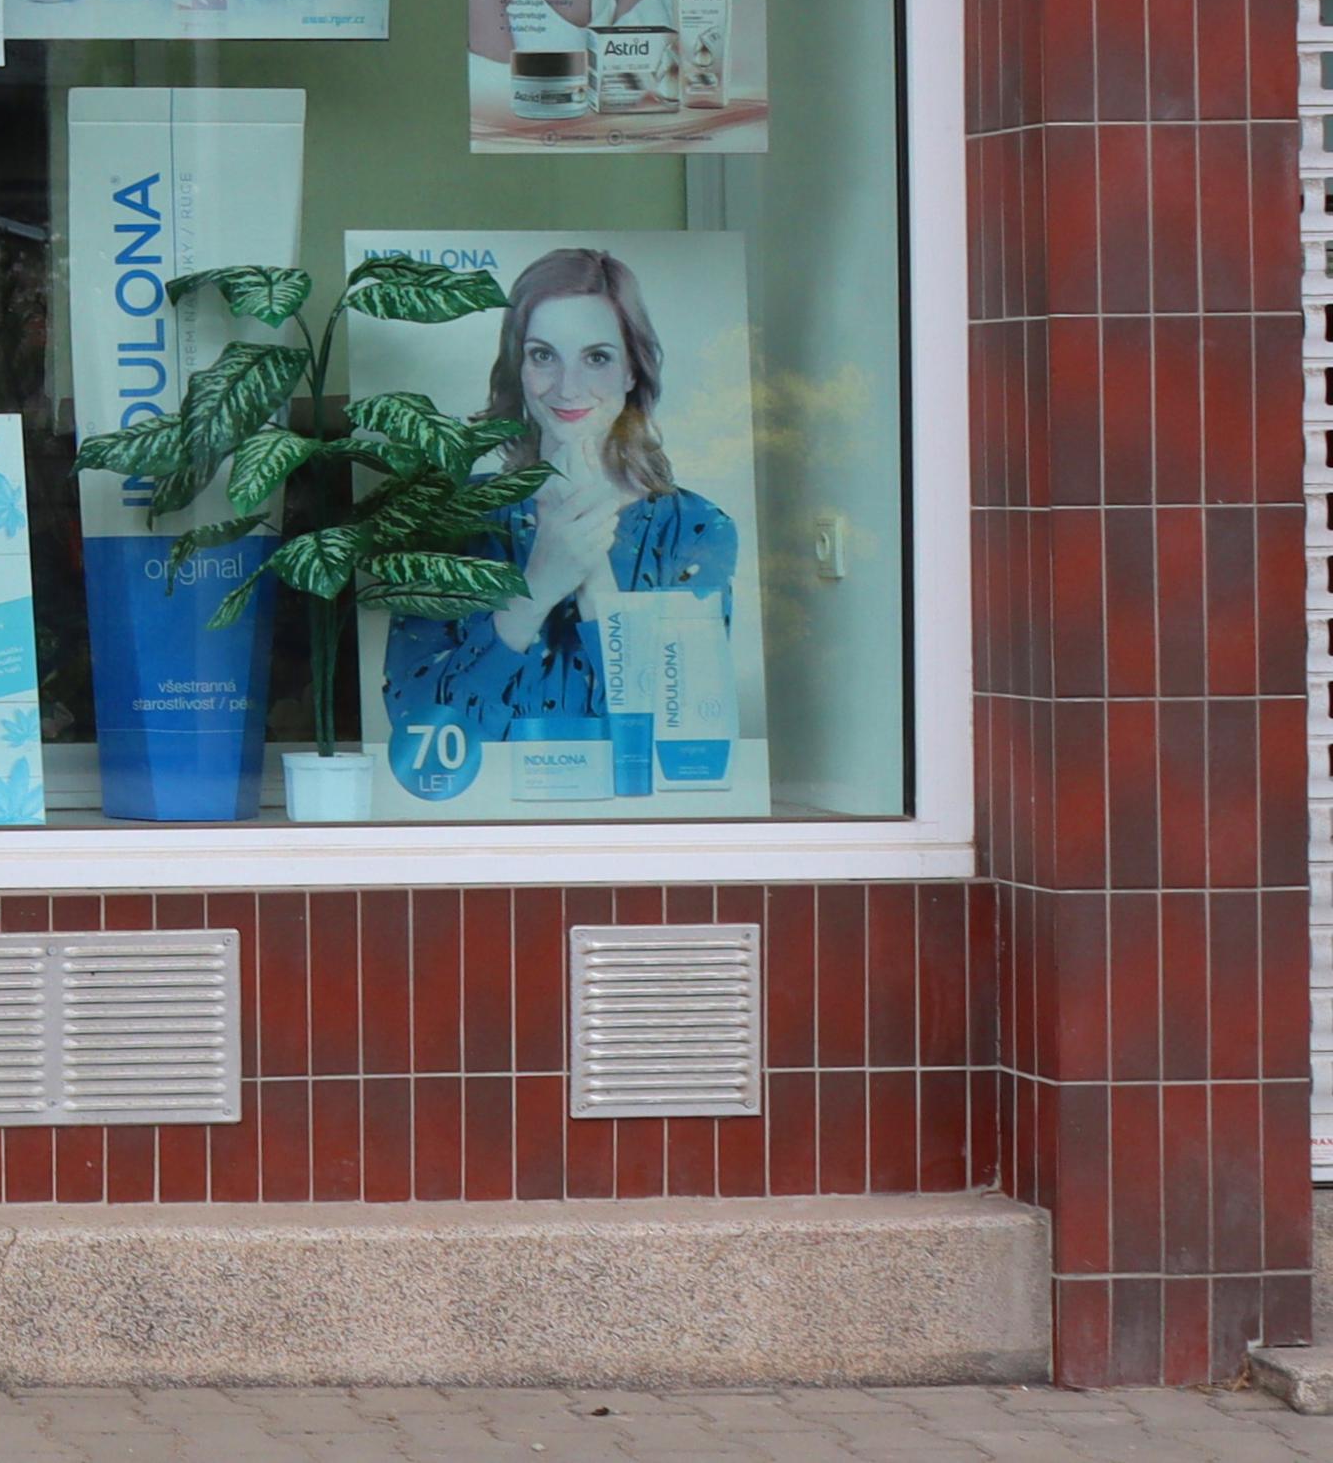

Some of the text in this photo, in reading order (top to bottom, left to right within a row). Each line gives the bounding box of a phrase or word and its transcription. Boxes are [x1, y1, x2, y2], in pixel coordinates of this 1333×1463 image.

[604, 39, 650, 56] Astrid
[144, 552, 244, 586] orginal
[607, 611, 624, 707] INDULONA
[157, 678, 237, 694] všestranná
[663, 641, 680, 728] INDULONA
[406, 724, 466, 770] 70
[523, 754, 588, 766] INDULONA
[419, 774, 457, 793] LET
